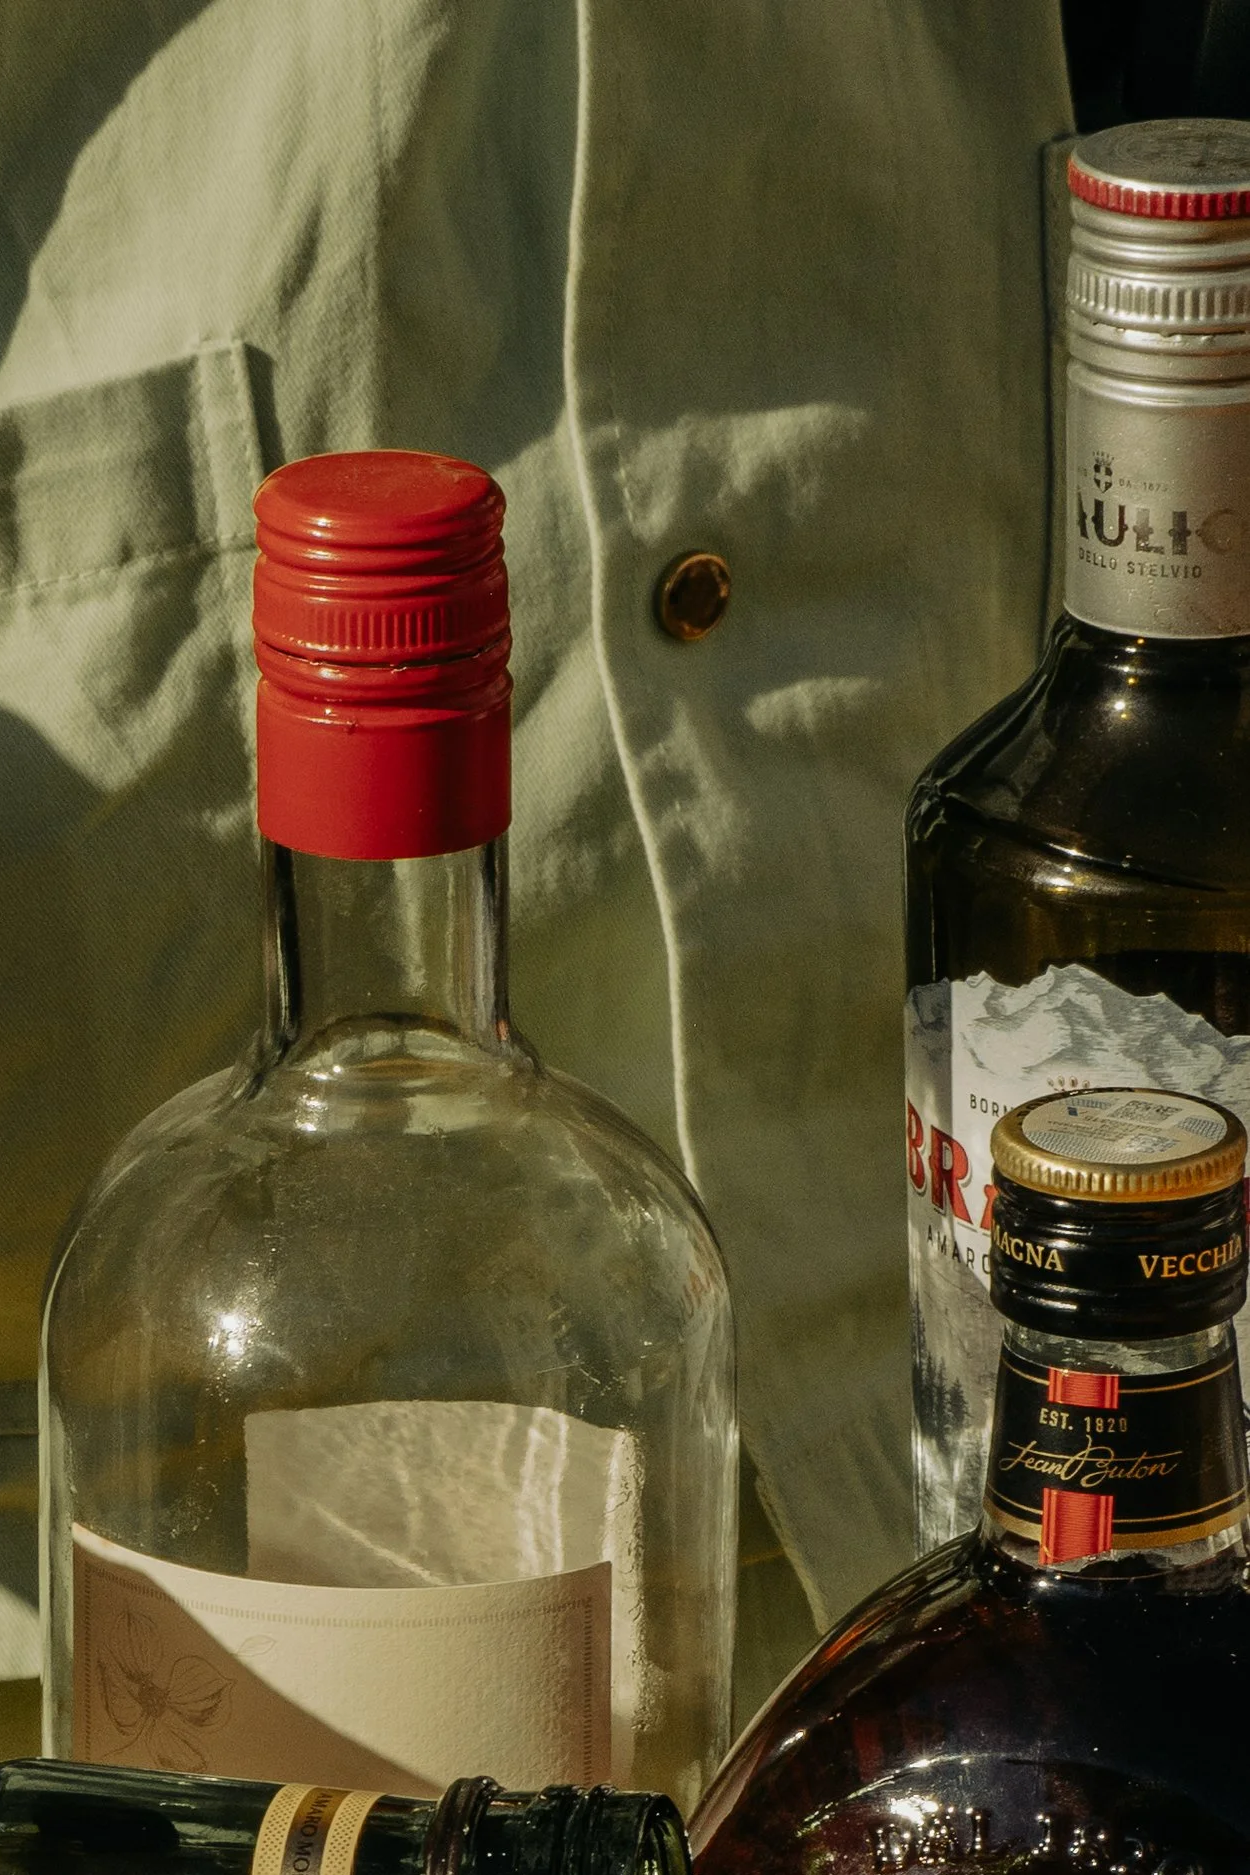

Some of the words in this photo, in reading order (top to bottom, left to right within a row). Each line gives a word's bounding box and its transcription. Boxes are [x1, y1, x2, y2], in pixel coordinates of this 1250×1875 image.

[1079, 548, 1117, 570] DELLO
[1127, 561, 1202, 579] STELVIO
[992, 1220, 1066, 1273] MAGNA
[1138, 1234, 1242, 1279] VECCHIA
[1038, 1407, 1074, 1432] EST.
[1084, 1416, 1128, 1432] 1820
[300, 1793, 333, 1837] AMARO
